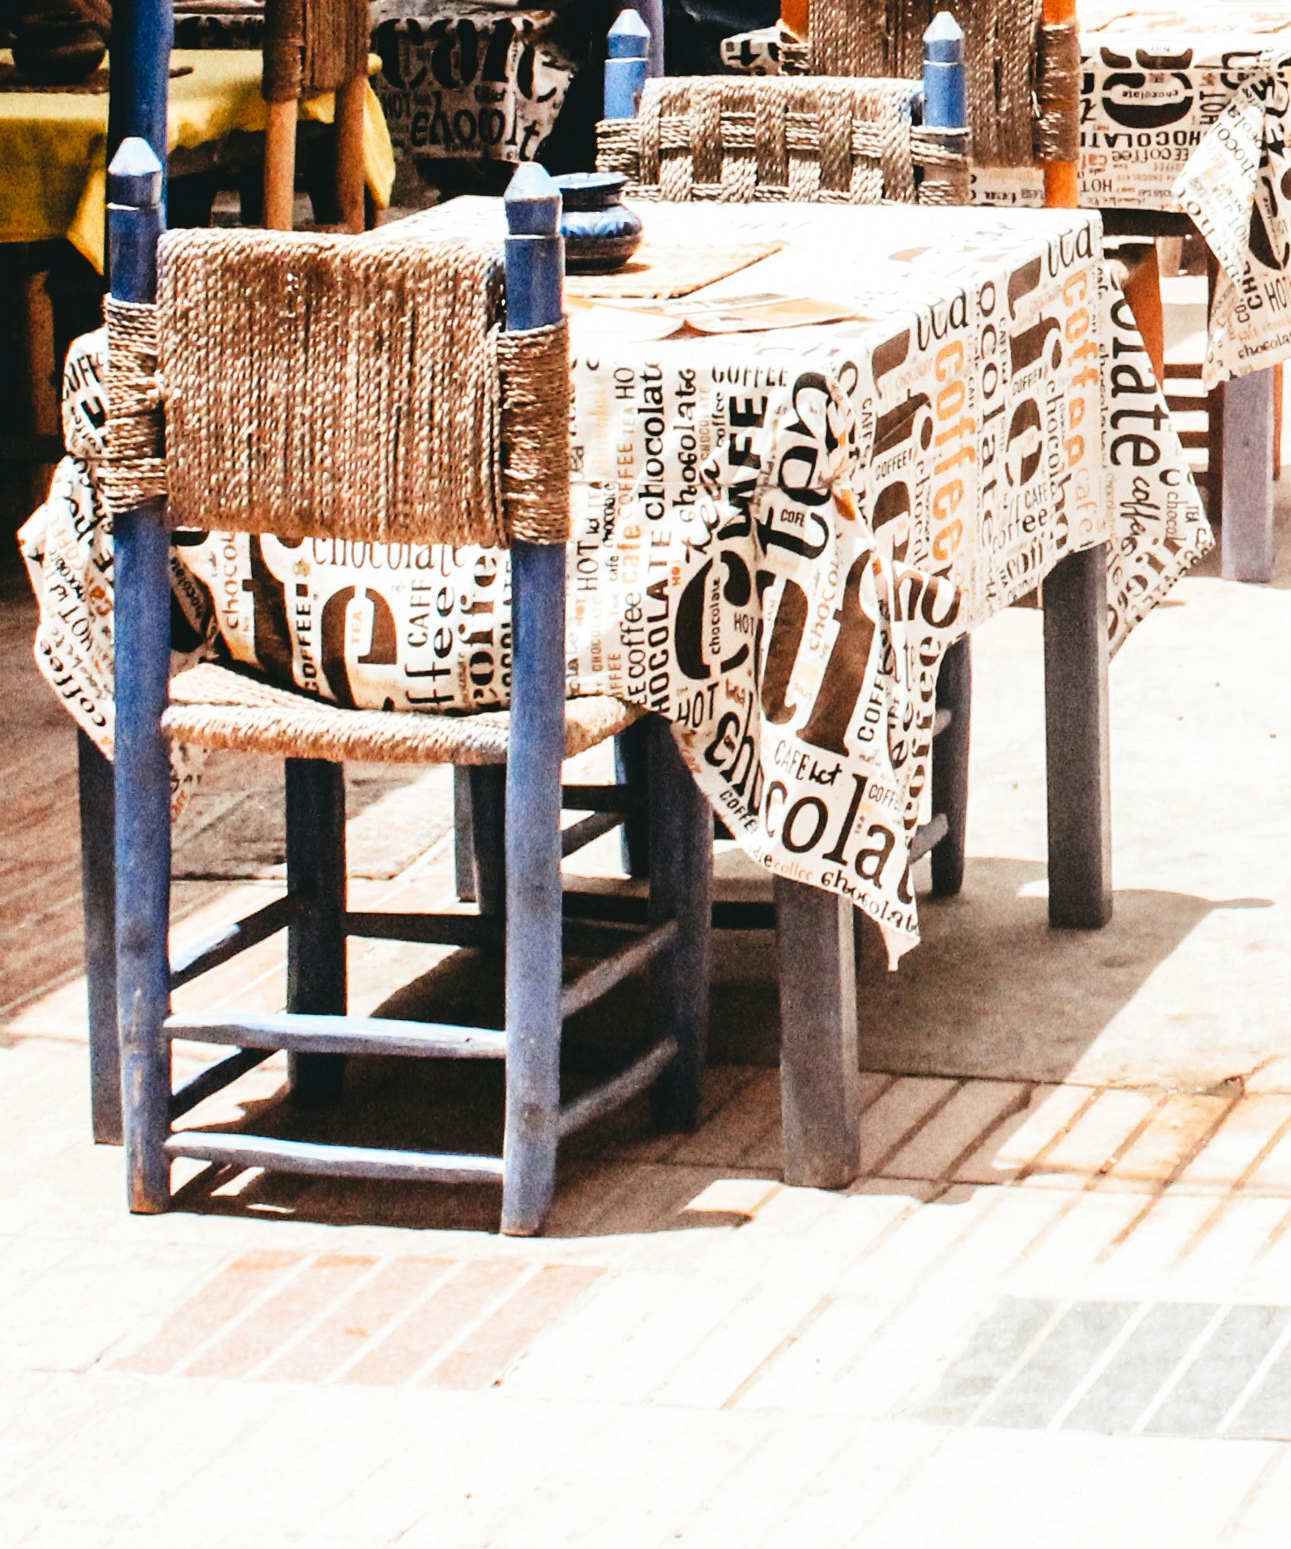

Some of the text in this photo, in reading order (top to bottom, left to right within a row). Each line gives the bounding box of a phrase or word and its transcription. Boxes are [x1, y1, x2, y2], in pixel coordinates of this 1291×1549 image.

[1120, 89, 1180, 100] chocolate
[1112, 148, 1172, 163] coffee
[1080, 179, 1112, 193] HOT
[672, 367, 698, 524] chocolate
[712, 391, 726, 449] coffee
[930, 339, 977, 562] coffee
[1071, 465, 1100, 538] cafe
[576, 539, 600, 592] HOT
[603, 555, 619, 583] cafe
[616, 523, 642, 584] cafe
[350, 609, 363, 645] TEA
[619, 591, 646, 680] coffee
[708, 576, 722, 656] chocolate
[295, 602, 318, 693] COFFEE
[40, 637, 108, 730] coffee
[774, 739, 810, 782] CAFE
